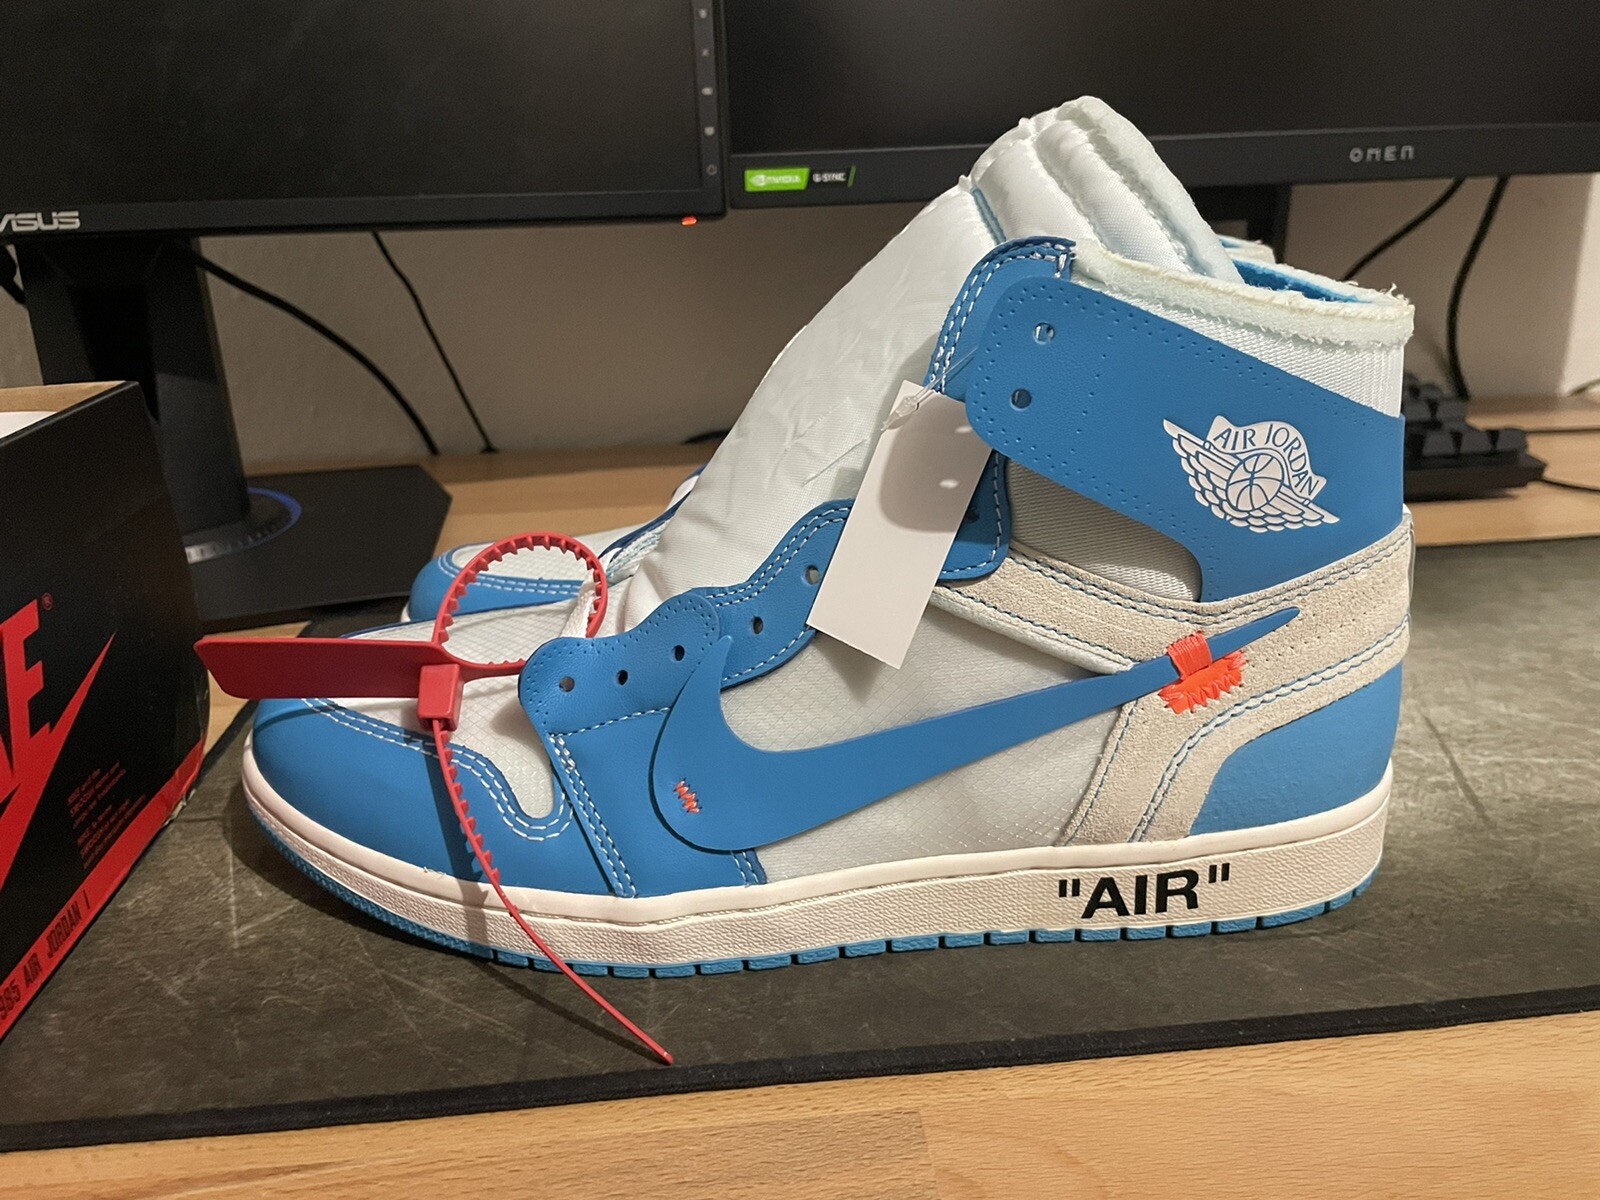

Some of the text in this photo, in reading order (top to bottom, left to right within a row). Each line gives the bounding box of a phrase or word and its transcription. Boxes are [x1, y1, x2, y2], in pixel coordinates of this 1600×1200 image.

[1349, 145, 1414, 163] OMEN
[0, 210, 80, 232] ASUS
[1213, 424, 1319, 496] AIR JORDAN
[23, 953, 42, 988] AIR
[46, 901, 82, 959] JORDAN
